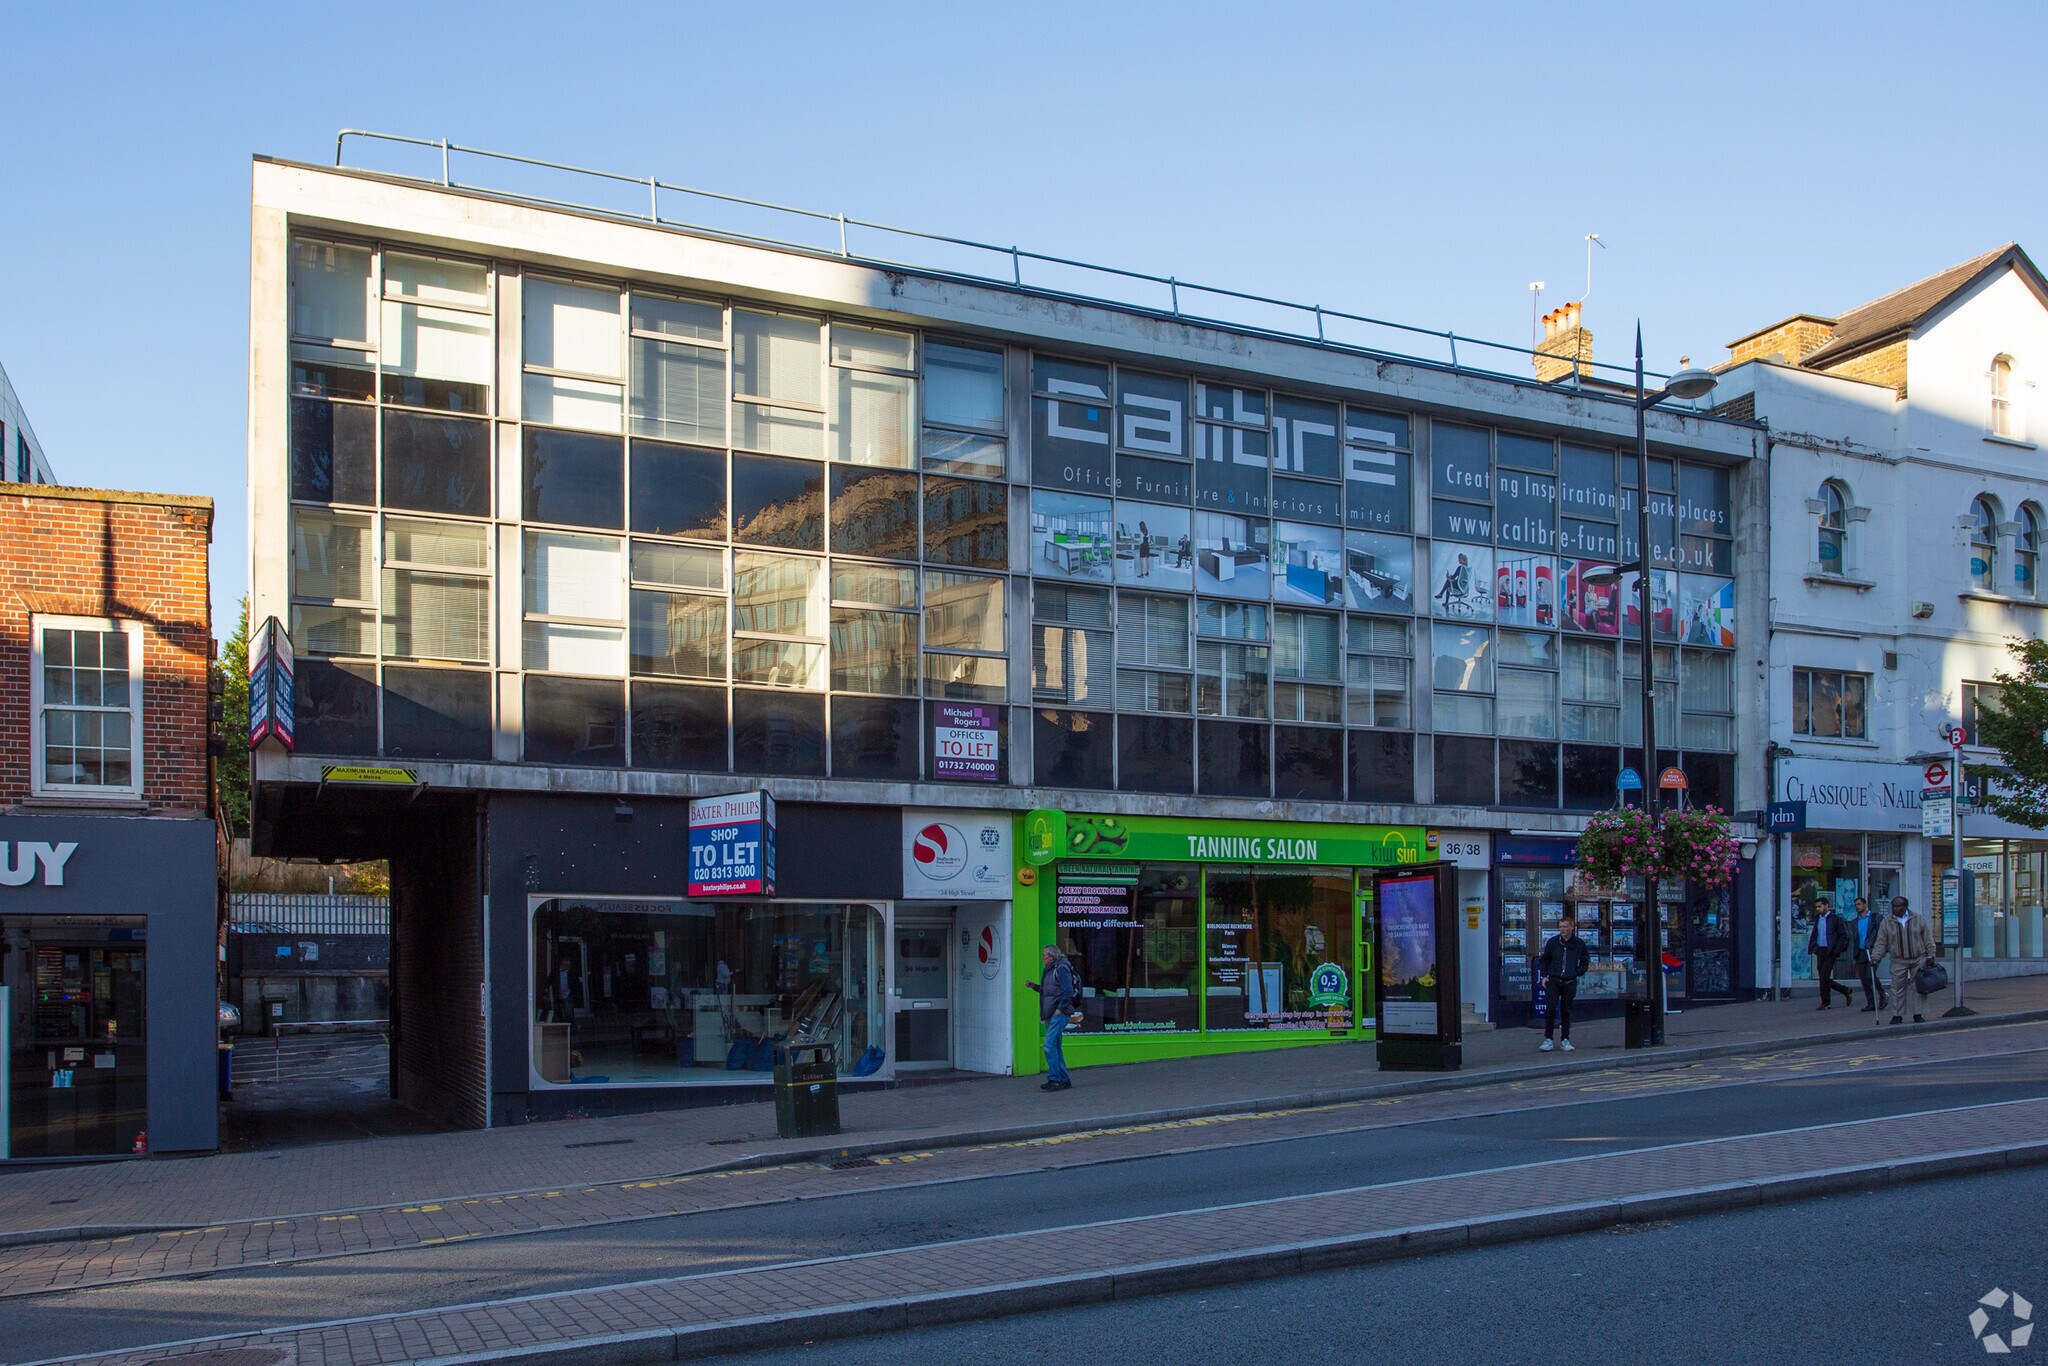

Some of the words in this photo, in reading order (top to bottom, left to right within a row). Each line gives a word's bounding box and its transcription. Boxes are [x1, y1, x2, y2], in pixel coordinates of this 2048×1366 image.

[1048, 378, 1395, 485] calibre
[1064, 467, 1122, 488] Office
[1137, 476, 1218, 501] Furniture
[1228, 490, 1236, 503] &
[1246, 493, 1322, 514] Interiors
[1336, 503, 1390, 523] Lmited
[1447, 464, 1519, 498] Creatng
[1646, 494, 1724, 523] orkplaces
[1449, 514, 1714, 567] www.calibre-furnitue.co.uk
[943, 707, 973, 718] Michael
[954, 717, 980, 728] Rogers
[950, 730, 984, 740] OFFICES
[1952, 731, 1962, 744] B
[941, 741, 962, 755] TO
[968, 743, 993, 757] LET
[939, 761, 964, 770] 01732
[966, 762, 995, 772] 740000
[1786, 776, 1867, 810] CLASSIQUE
[691, 805, 722, 821] BAXTER
[725, 801, 759, 817] PHILIPS
[1771, 808, 1795, 827] jdm
[711, 827, 739, 842] SHOP
[692, 844, 717, 867] TO
[722, 841, 759, 866] LET
[1187, 835, 1261, 859] TANNING
[1267, 838, 1317, 861] SALON
[1372, 842, 1418, 864] kiwisun
[1446, 843, 1480, 856] 36/38
[694, 868, 710, 880] 020
[711, 866, 733, 880] 8313
[734, 865, 756, 878] 9000
[1058, 864, 1080, 874] GREEN
[1110, 865, 1140, 876] TANNING
[703, 882, 747, 893] baxterphilips.co.uk
[1064, 887, 1082, 895] SEXY
[1082, 887, 1109, 895] BROWN
[1109, 887, 1127, 895] SKIN
[1064, 896, 1093, 904] VITAMIN
[1064, 906, 1088, 914] HAPPY
[1088, 906, 1129, 914] HORMONES
[1058, 920, 1102, 930] something
[1321, 974, 1338, 987] 0,3
